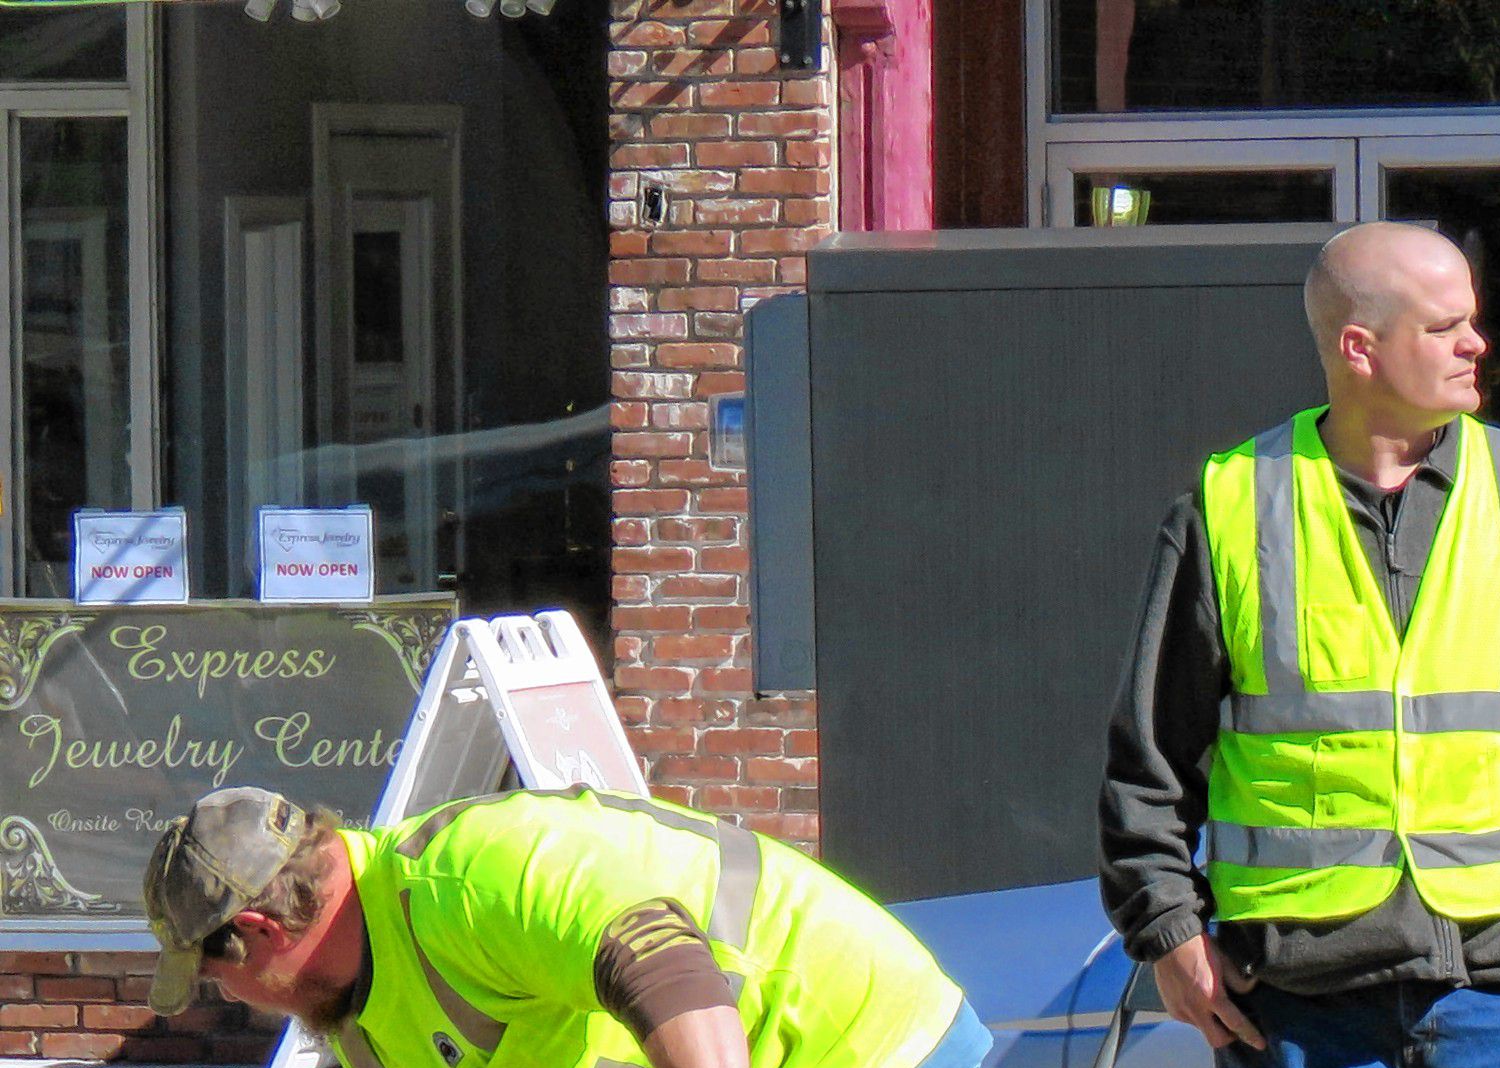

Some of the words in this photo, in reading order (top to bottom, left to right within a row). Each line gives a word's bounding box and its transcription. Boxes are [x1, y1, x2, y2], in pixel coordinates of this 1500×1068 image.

[91, 565, 129, 579] NOW
[133, 565, 173, 579] OPEN
[276, 563, 314, 577] NOW
[318, 563, 358, 577] OPEN
[109, 624, 337, 700] Express
[19, 713, 246, 790] Jewelry
[254, 711, 405, 769] Cente
[47, 808, 121, 832] Onsite
